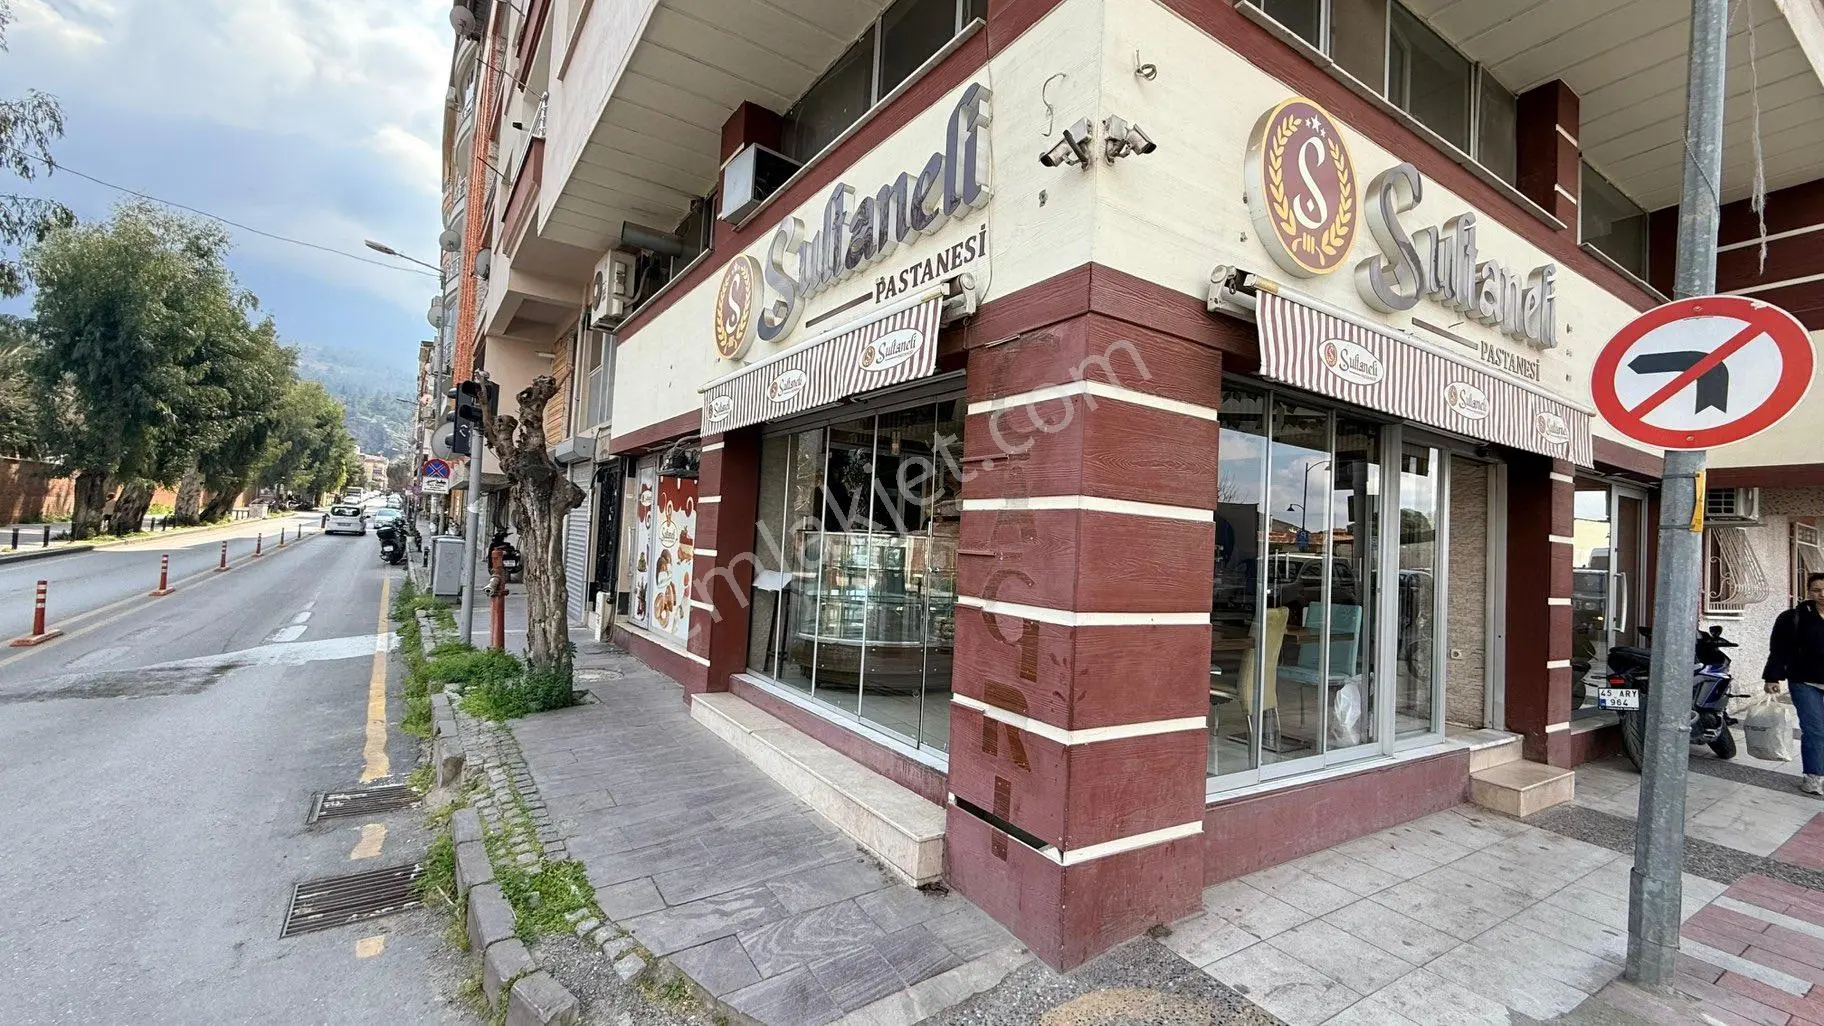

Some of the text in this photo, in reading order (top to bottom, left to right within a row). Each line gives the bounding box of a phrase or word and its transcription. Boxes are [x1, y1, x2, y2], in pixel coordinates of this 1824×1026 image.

[757, 82, 993, 343] Sultaneli
[874, 223, 988, 304] PASTANESİ
[1480, 340, 1541, 382] PASTANESİ
